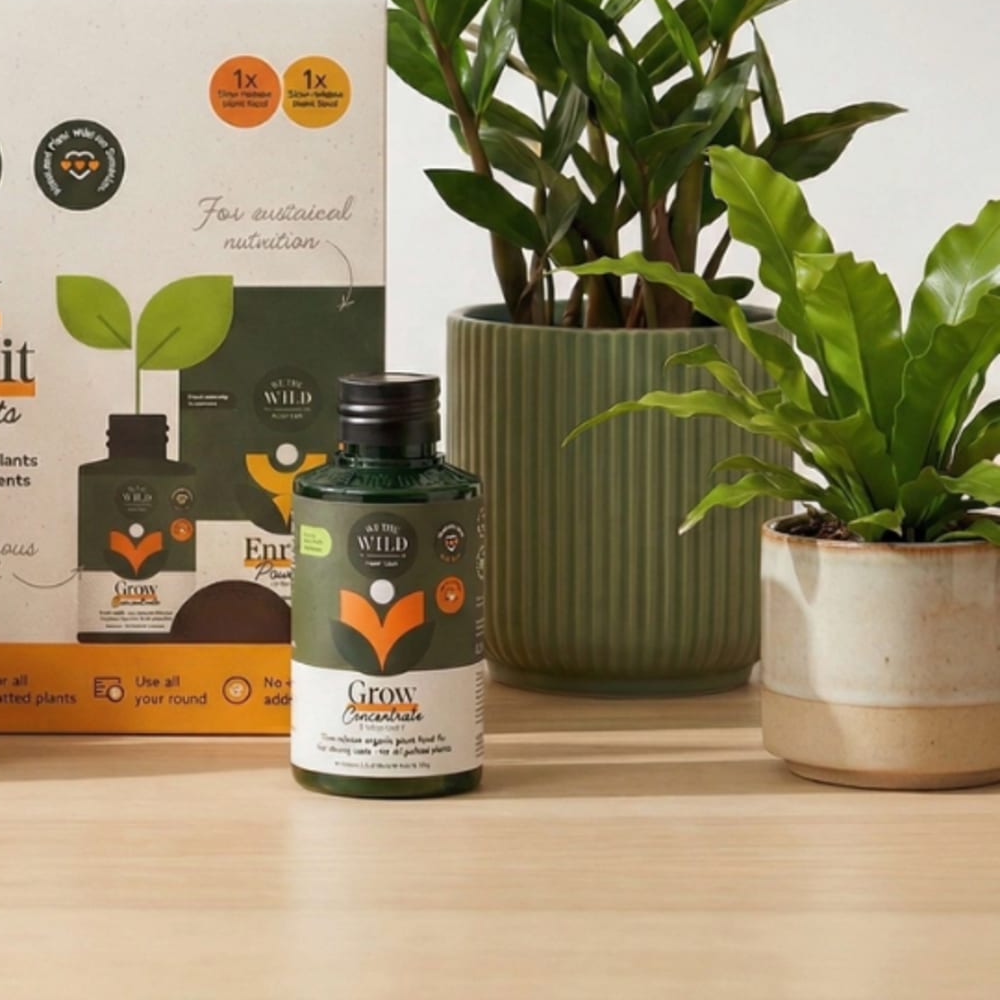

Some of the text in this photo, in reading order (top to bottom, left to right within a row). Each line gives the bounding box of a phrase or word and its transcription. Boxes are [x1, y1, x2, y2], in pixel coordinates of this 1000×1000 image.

[233, 68, 258, 90] 1x
[303, 68, 328, 90] 1x
[246, 537, 291, 560] Enr
[357, 535, 409, 553] WILD
[114, 580, 158, 597] Grow
[12, 674, 28, 687] all
[135, 675, 181, 688] Use all
[264, 676, 283, 689] No
[35, 691, 77, 707] plants
[134, 691, 208, 706] your round
[263, 692, 293, 706] add
[347, 679, 417, 705] Grow
[341, 705, 425, 725] Concentrate
